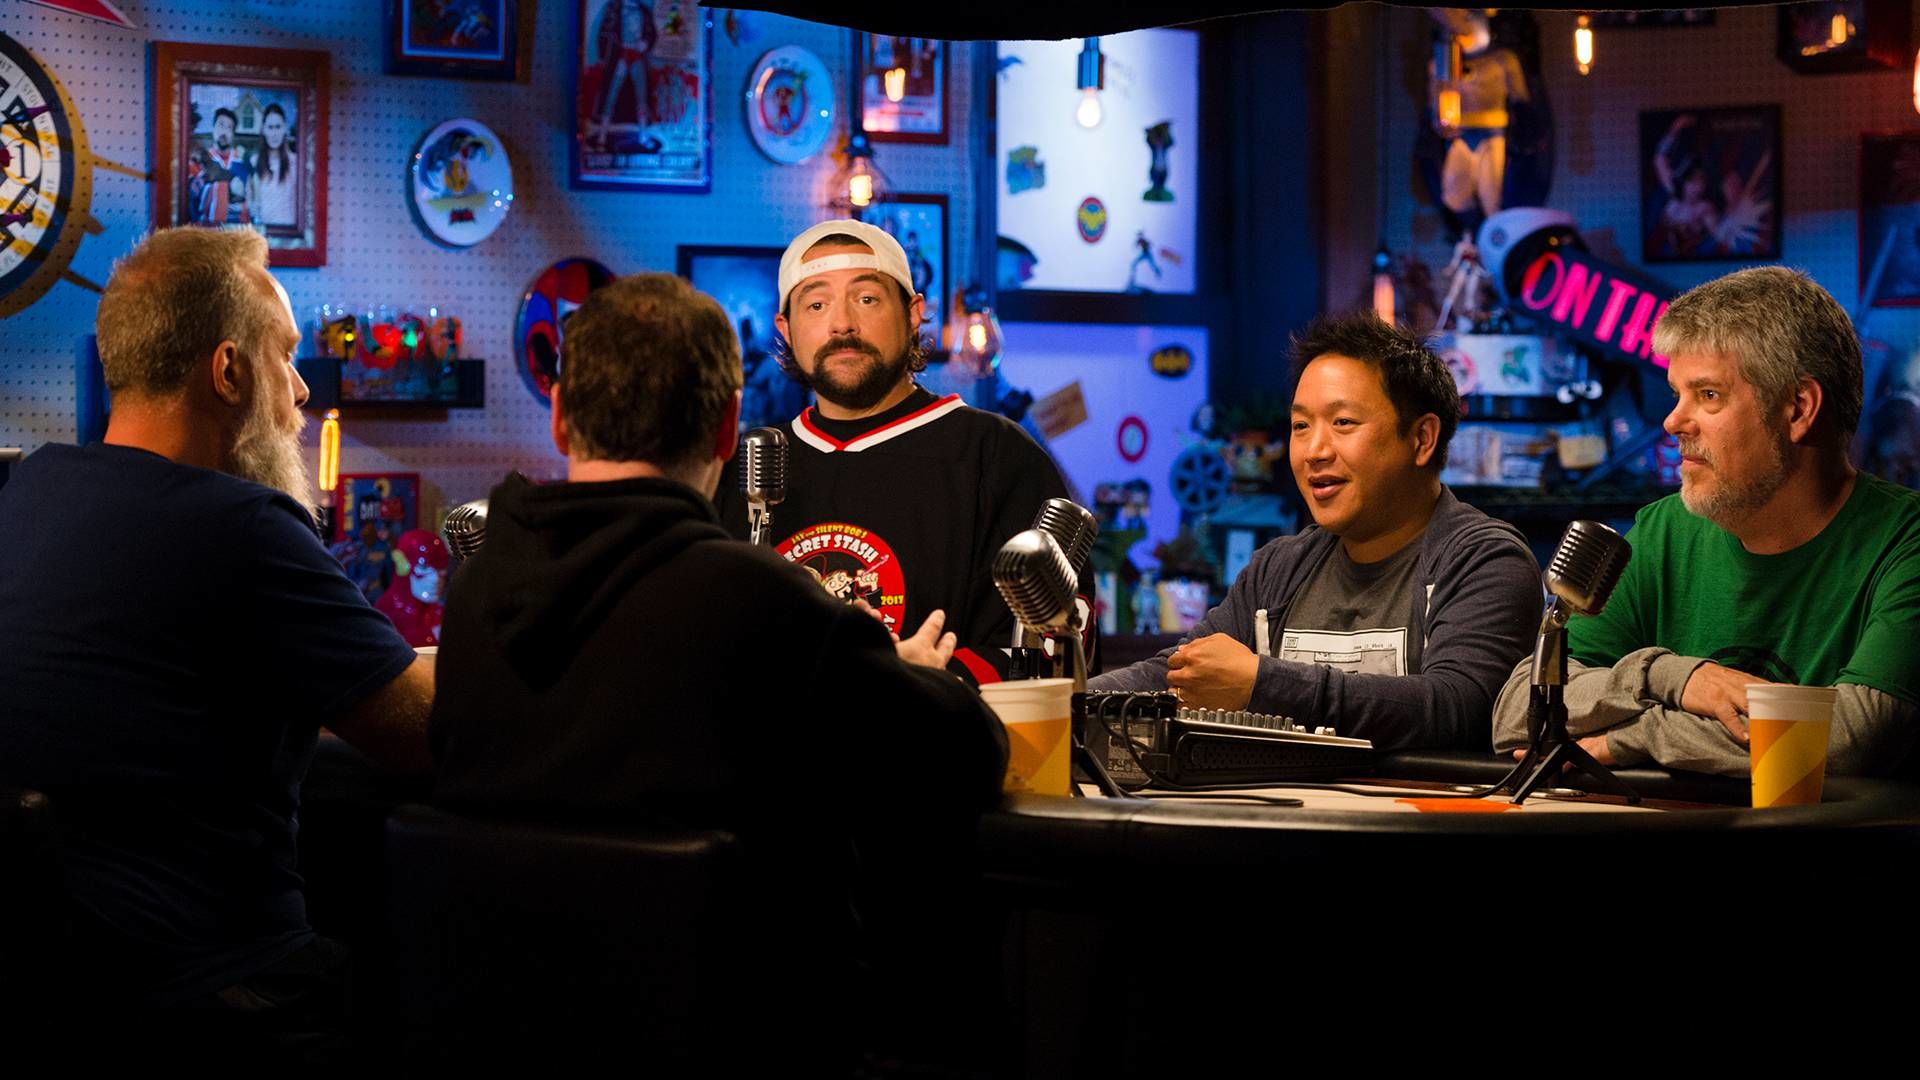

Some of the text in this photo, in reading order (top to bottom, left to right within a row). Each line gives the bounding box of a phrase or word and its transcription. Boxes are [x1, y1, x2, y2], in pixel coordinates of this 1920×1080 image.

[1520, 251, 1670, 369] ON TH
[816, 525, 843, 534] SILENT
[783, 534, 879, 563] ECRET STASH
[880, 595, 904, 606] 2017
